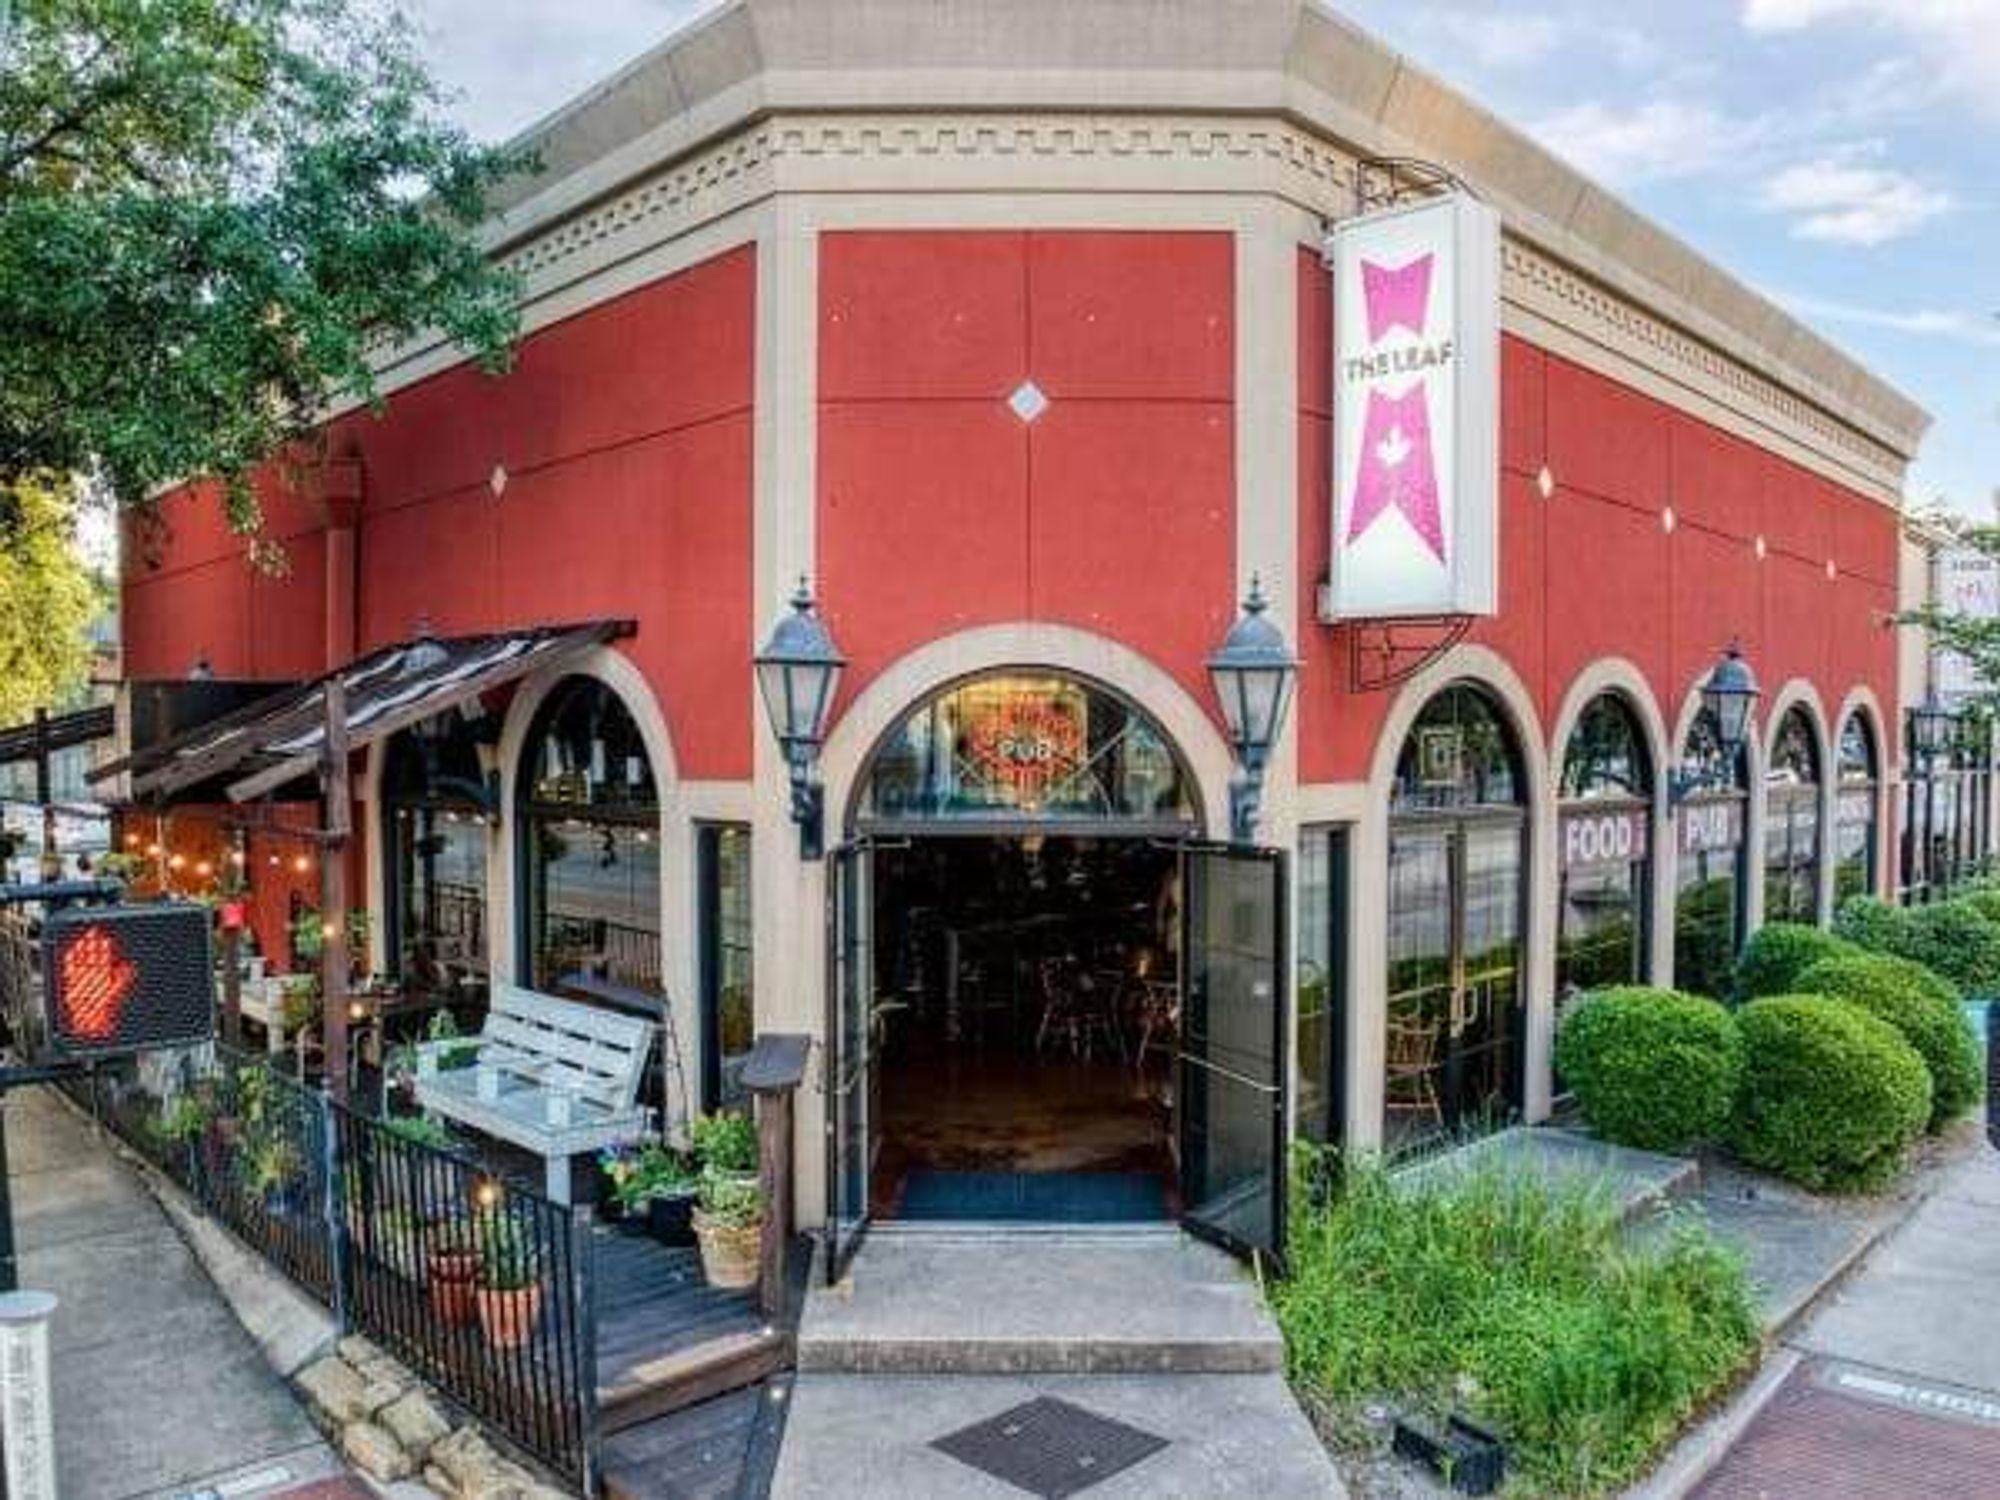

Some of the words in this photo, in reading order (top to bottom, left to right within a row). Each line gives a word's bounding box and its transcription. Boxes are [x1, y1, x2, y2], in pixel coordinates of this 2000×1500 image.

[1345, 353, 1388, 381] THE
[1393, 340, 1452, 373] LEAF
[1566, 815, 1632, 864] FOOD
